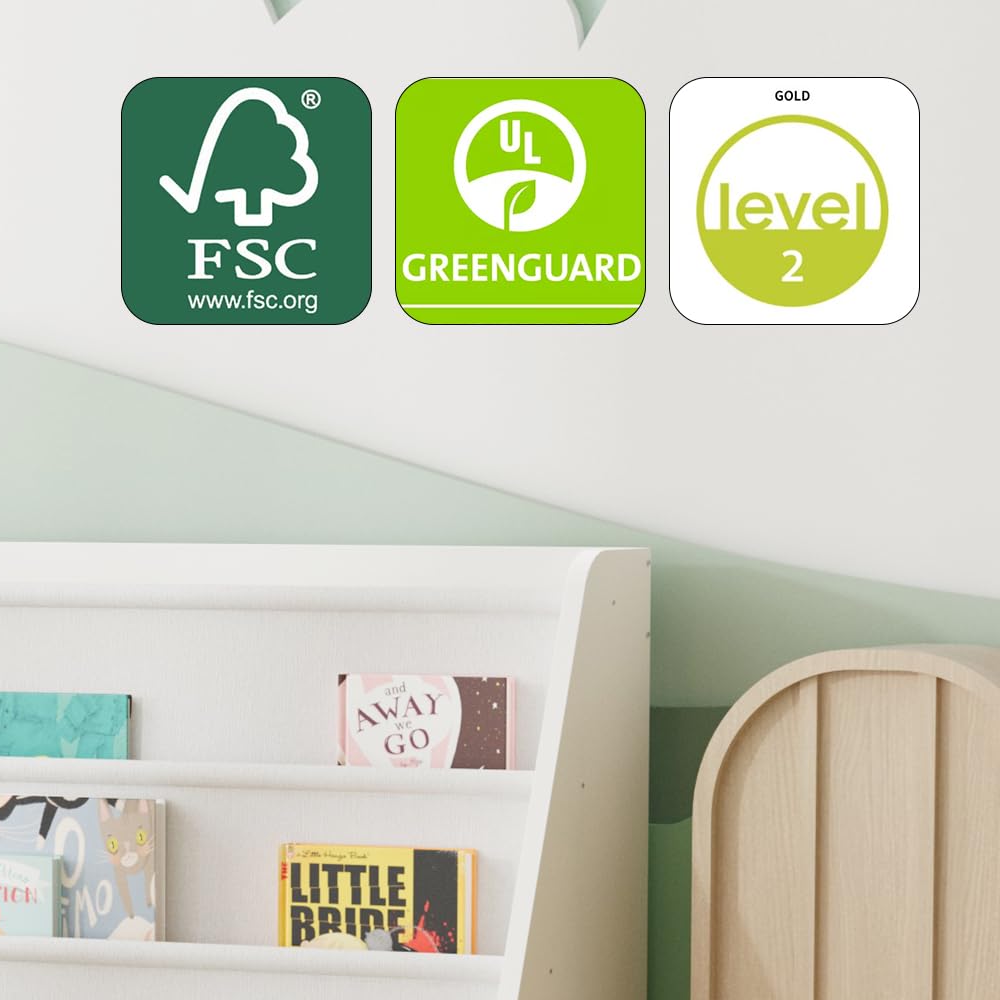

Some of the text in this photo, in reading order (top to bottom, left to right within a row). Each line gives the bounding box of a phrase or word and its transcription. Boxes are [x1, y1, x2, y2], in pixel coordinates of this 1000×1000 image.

[385, 681, 407, 696] and
[355, 693, 443, 732] AWAY
[395, 720, 413, 731] we
[384, 728, 430, 755] GO
[290, 862, 407, 907] LITTLE
